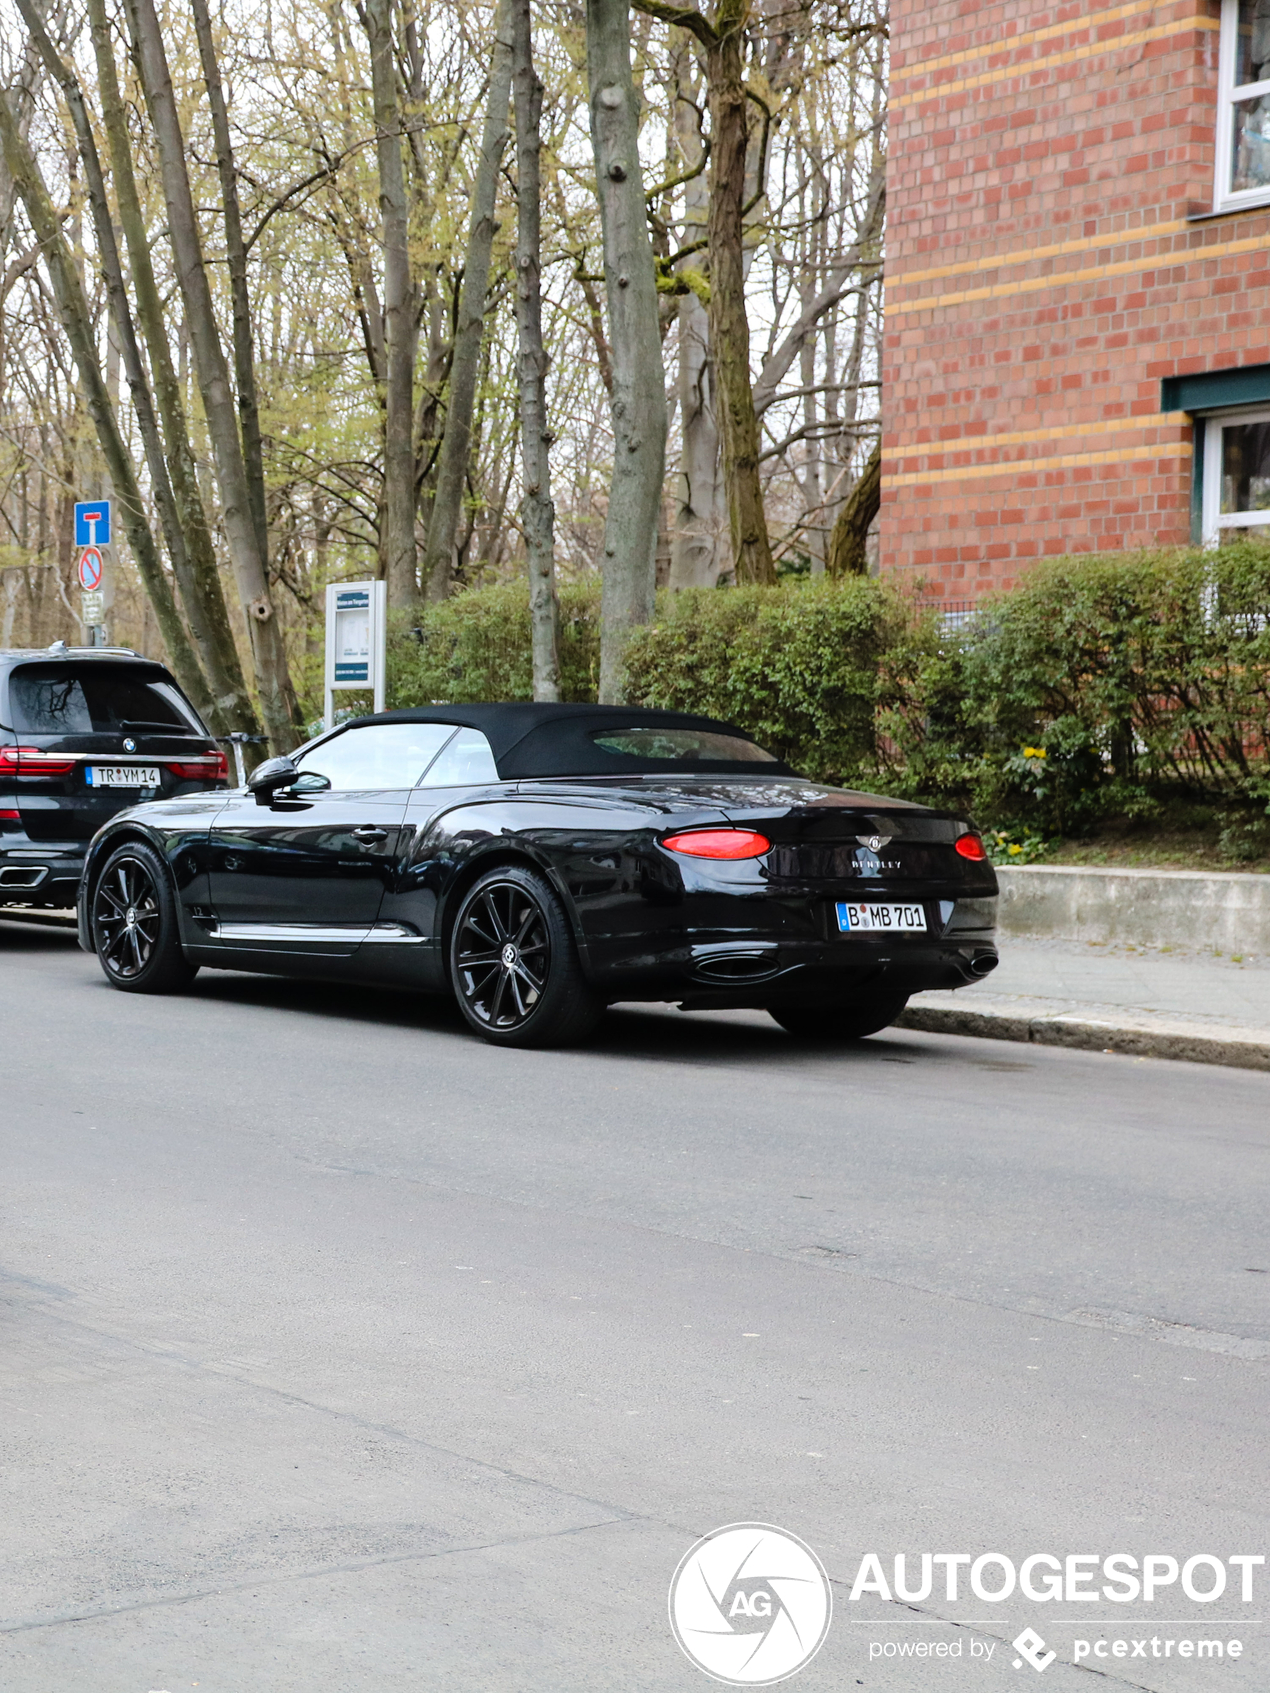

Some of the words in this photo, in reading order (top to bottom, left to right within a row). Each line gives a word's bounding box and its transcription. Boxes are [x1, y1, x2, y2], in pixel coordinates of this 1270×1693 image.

[98, 769, 114, 782] TR
[123, 769, 139, 782] YM
[141, 769, 156, 783] 14
[848, 906, 860, 927] B
[869, 906, 892, 927] MB
[894, 907, 924, 927] 701
